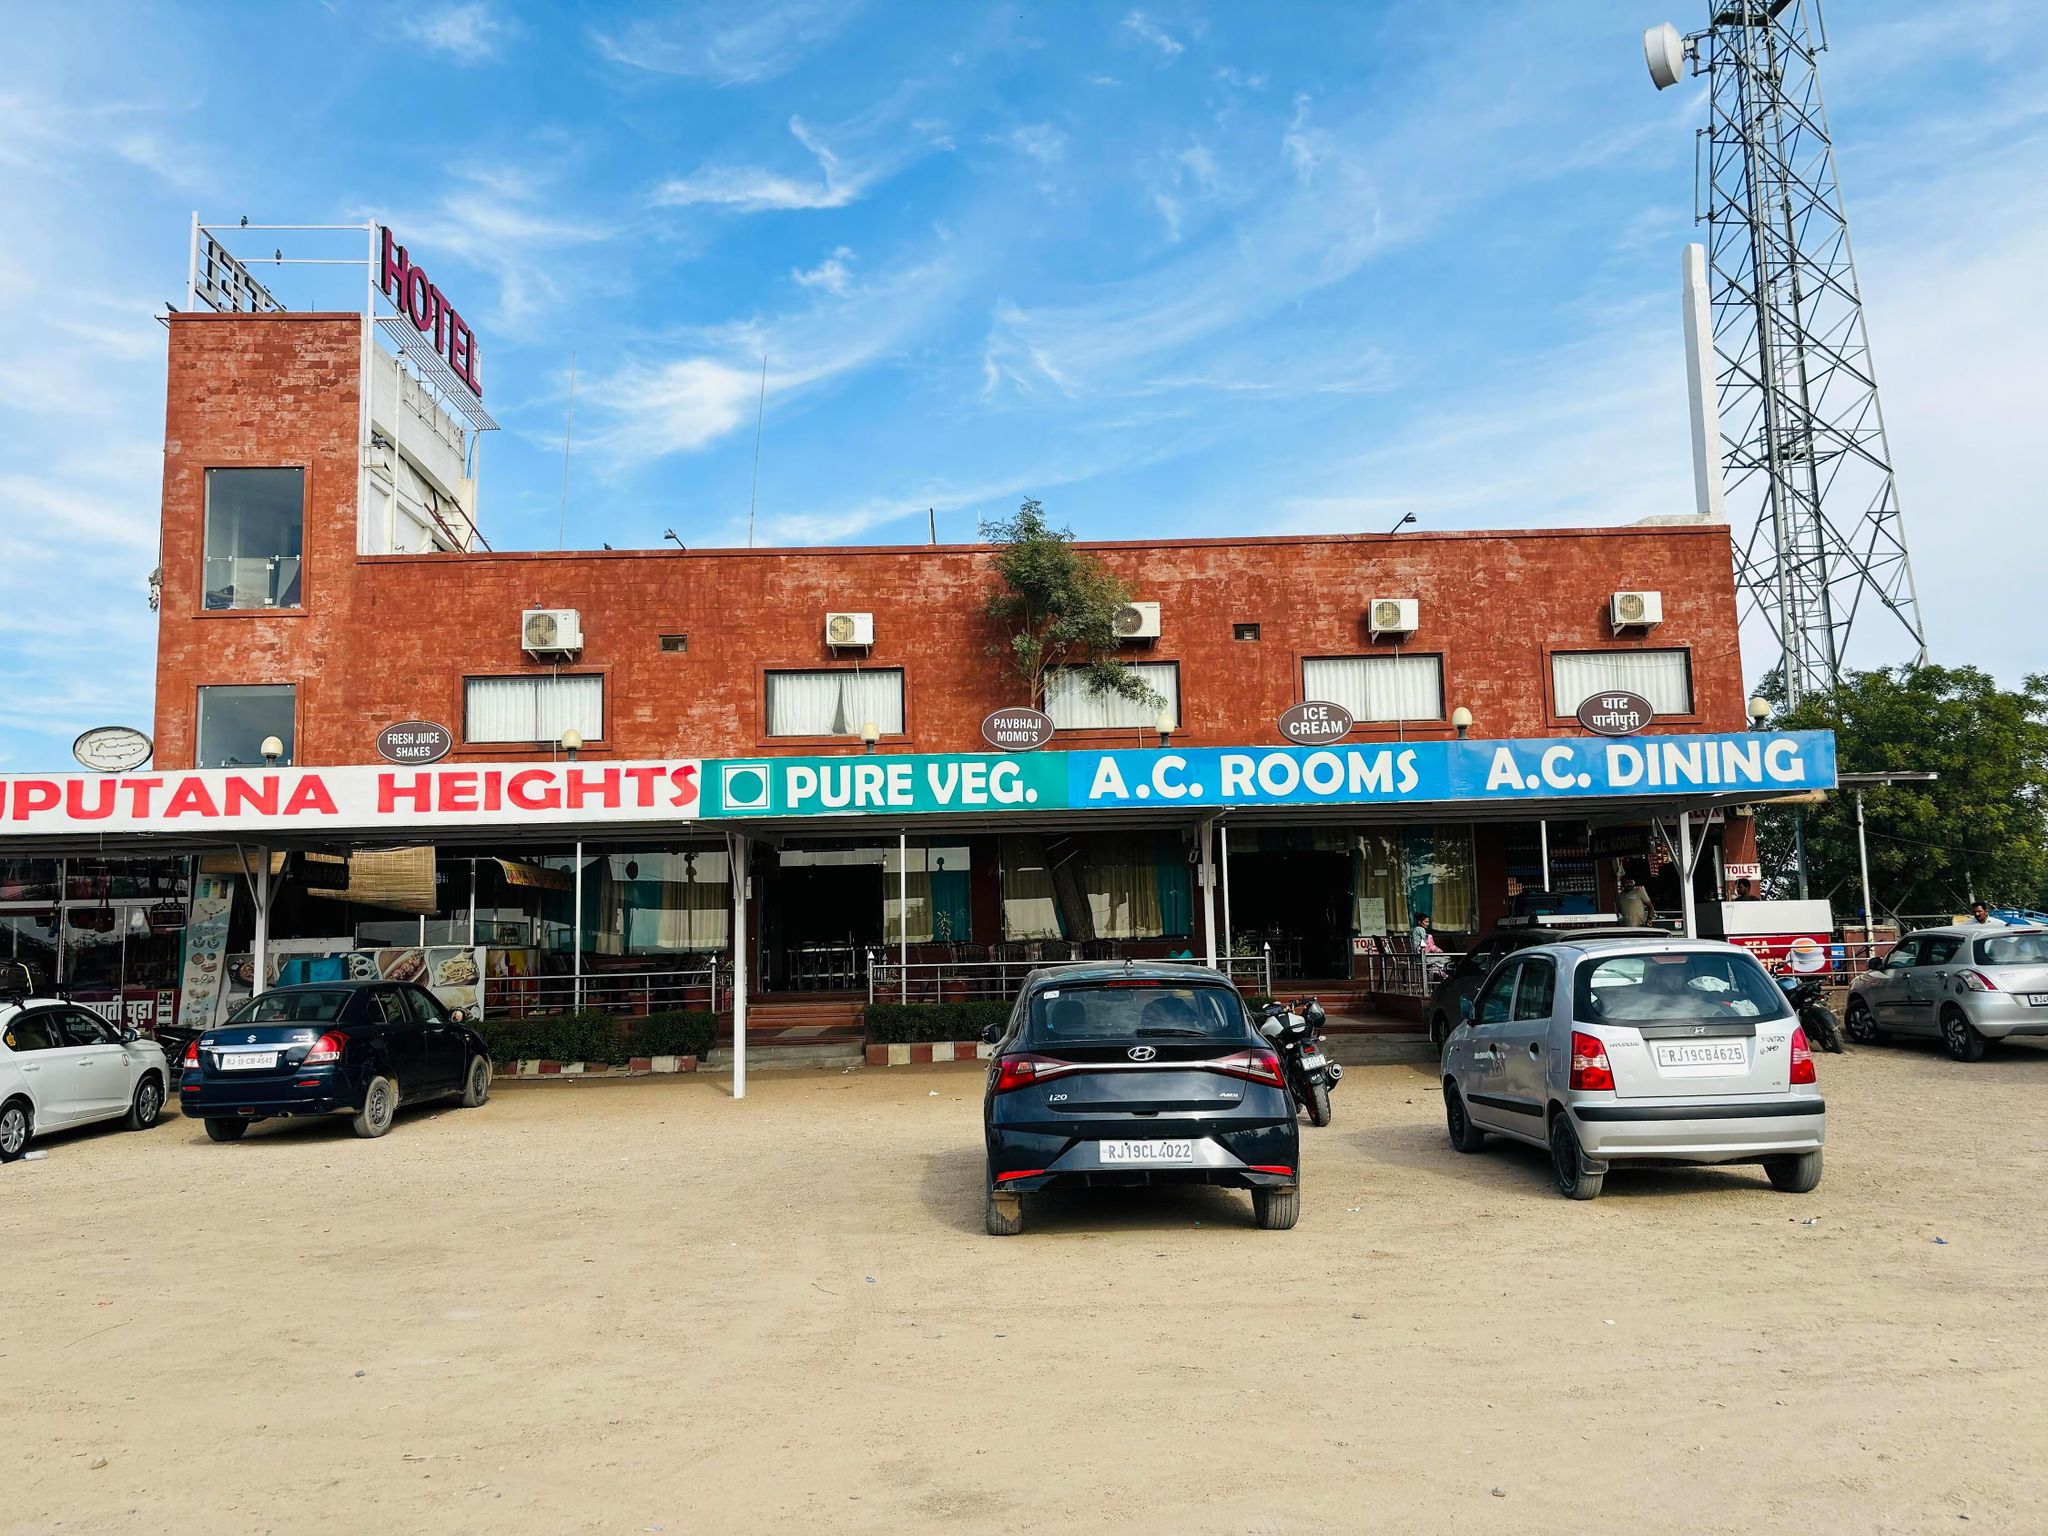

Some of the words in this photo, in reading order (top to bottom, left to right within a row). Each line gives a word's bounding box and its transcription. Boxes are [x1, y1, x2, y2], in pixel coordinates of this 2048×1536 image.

[381, 226, 482, 398] HOTEL
[1601, 697, 1629, 710] चाट
[1303, 706, 1328, 720] ICE
[994, 718, 1042, 729] PAVBHAJI
[1289, 720, 1343, 735] CREAM
[1592, 711, 1640, 731] पानीपुरी
[387, 733, 414, 744] FRESH
[416, 732, 440, 744] JUICE
[997, 731, 1038, 742] MOMO'S
[396, 746, 431, 757] SHAKES
[1486, 745, 1591, 790] A.C.
[1606, 738, 1805, 787] DINING
[1090, 756, 1203, 799] A.C.
[1221, 749, 1419, 796] ROOMS
[786, 764, 913, 808] PURE
[928, 762, 1038, 804] VEG.
[0, 775, 338, 820] PUTANA
[378, 766, 698, 813] HEIGHTS
[1610, 834, 1641, 850] ROOMS
[323, 867, 345, 882] FOOD
[1725, 865, 1759, 875] TOILET
[1666, 1047, 1743, 1063] RJ19CB4625
[1108, 1144, 1191, 1158] RJ19CL4022
